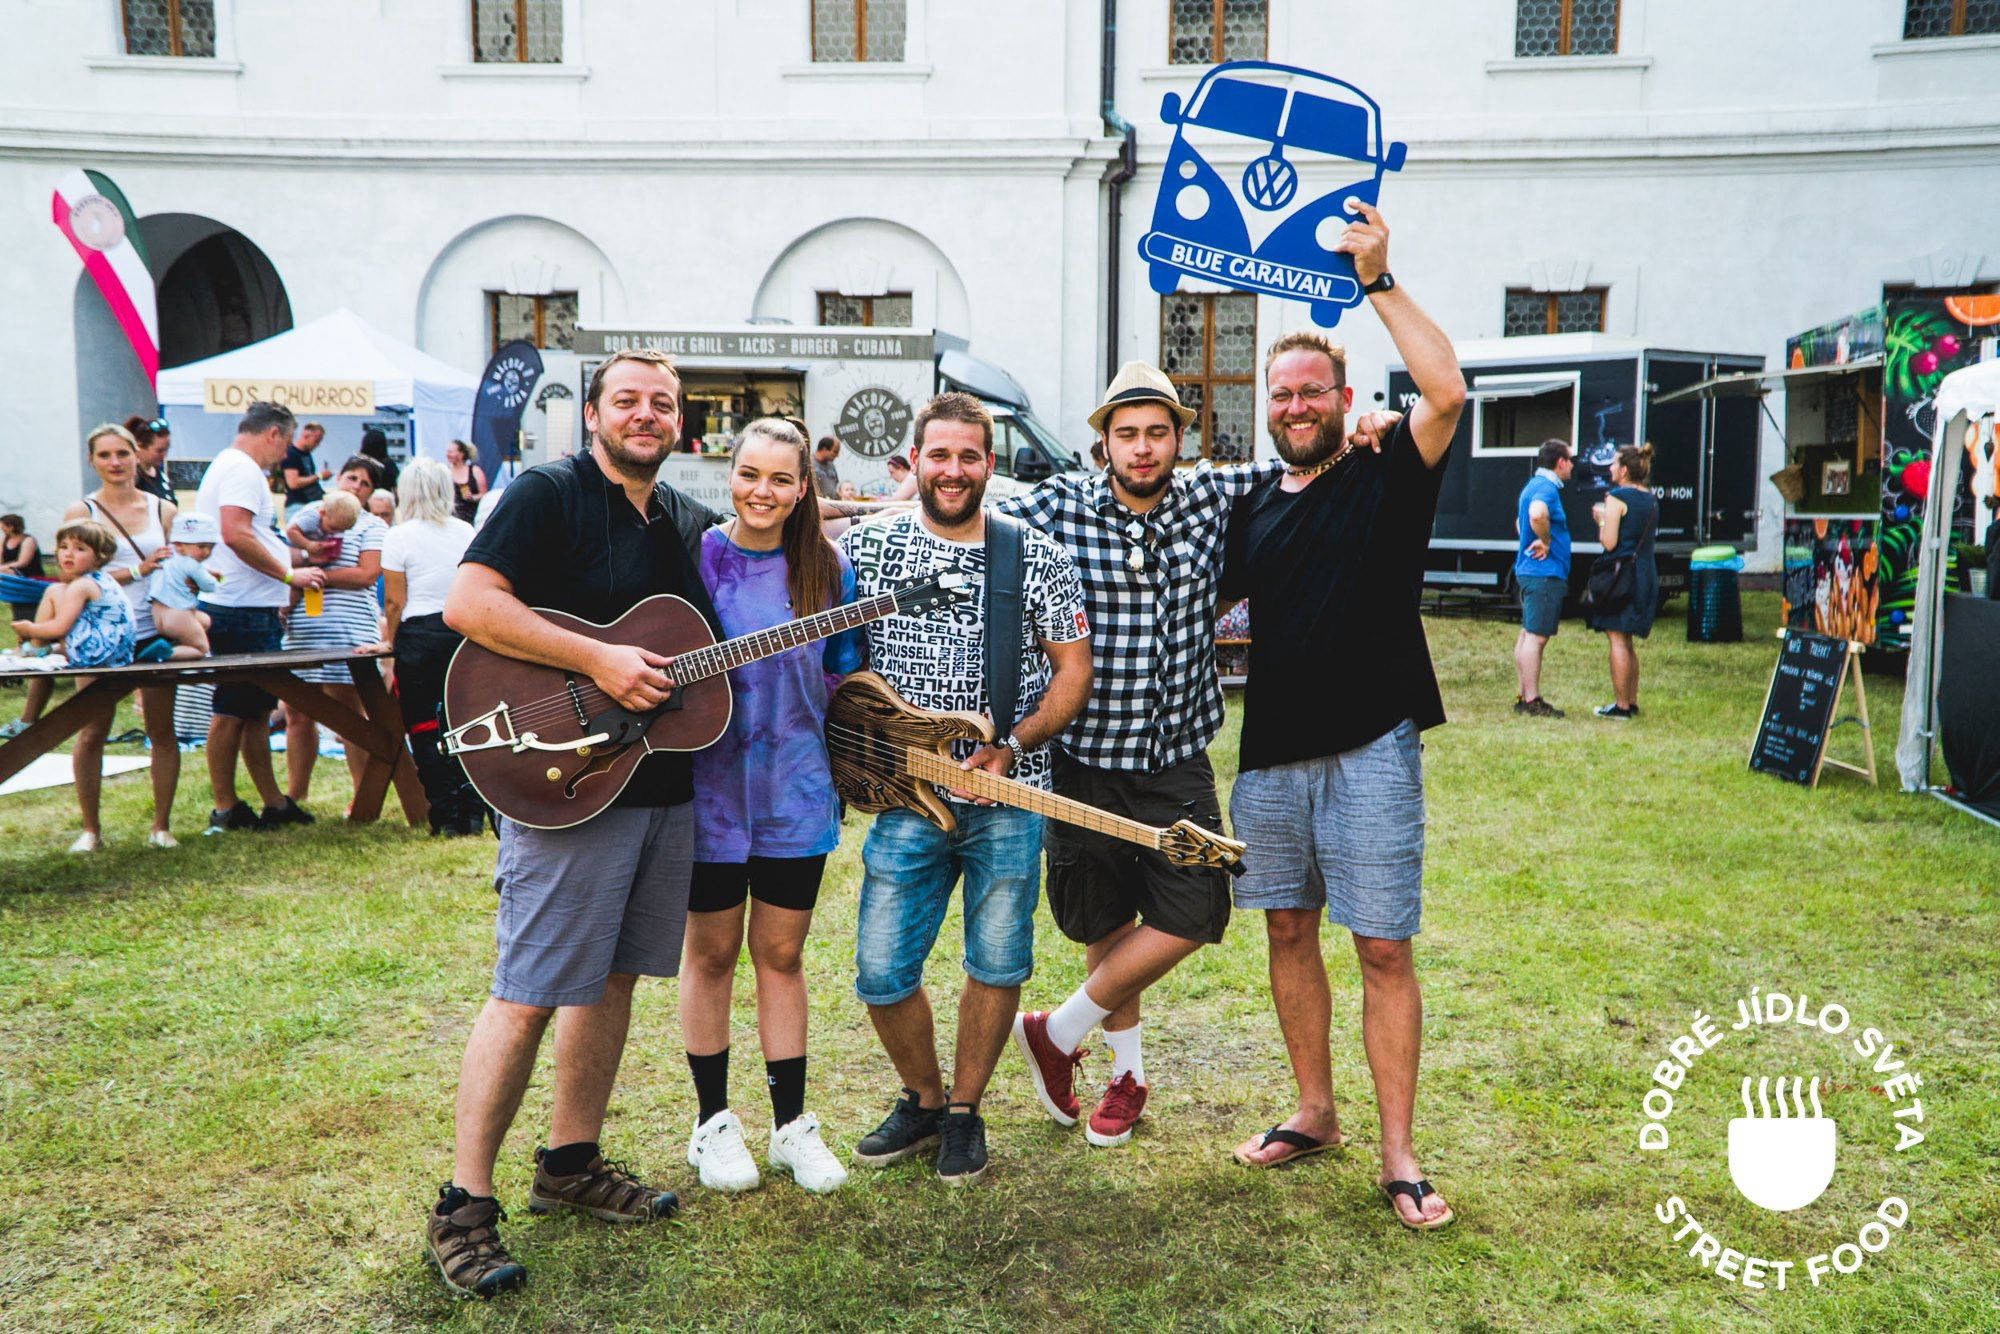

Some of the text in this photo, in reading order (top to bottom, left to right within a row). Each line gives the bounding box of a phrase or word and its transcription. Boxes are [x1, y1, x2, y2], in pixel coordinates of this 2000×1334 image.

[1171, 243, 1332, 298] BLUE CARAVAN
[645, 337, 686, 352] SMOKE
[690, 337, 722, 353] GRILL
[739, 338, 775, 354] TACOS
[791, 339, 838, 355] BURGER
[853, 340, 902, 356] CUBANA
[211, 384, 369, 409] LOS CHURROS
[1671, 487, 1693, 500] MON
[888, 619, 966, 638] RUSSELL
[888, 630, 965, 646] ATHLETIC
[887, 643, 936, 660] RUSSELL
[966, 629, 984, 678] RUSSELL
[885, 659, 936, 676] ATHLETIC
[937, 646, 951, 678] ATHLETIC
